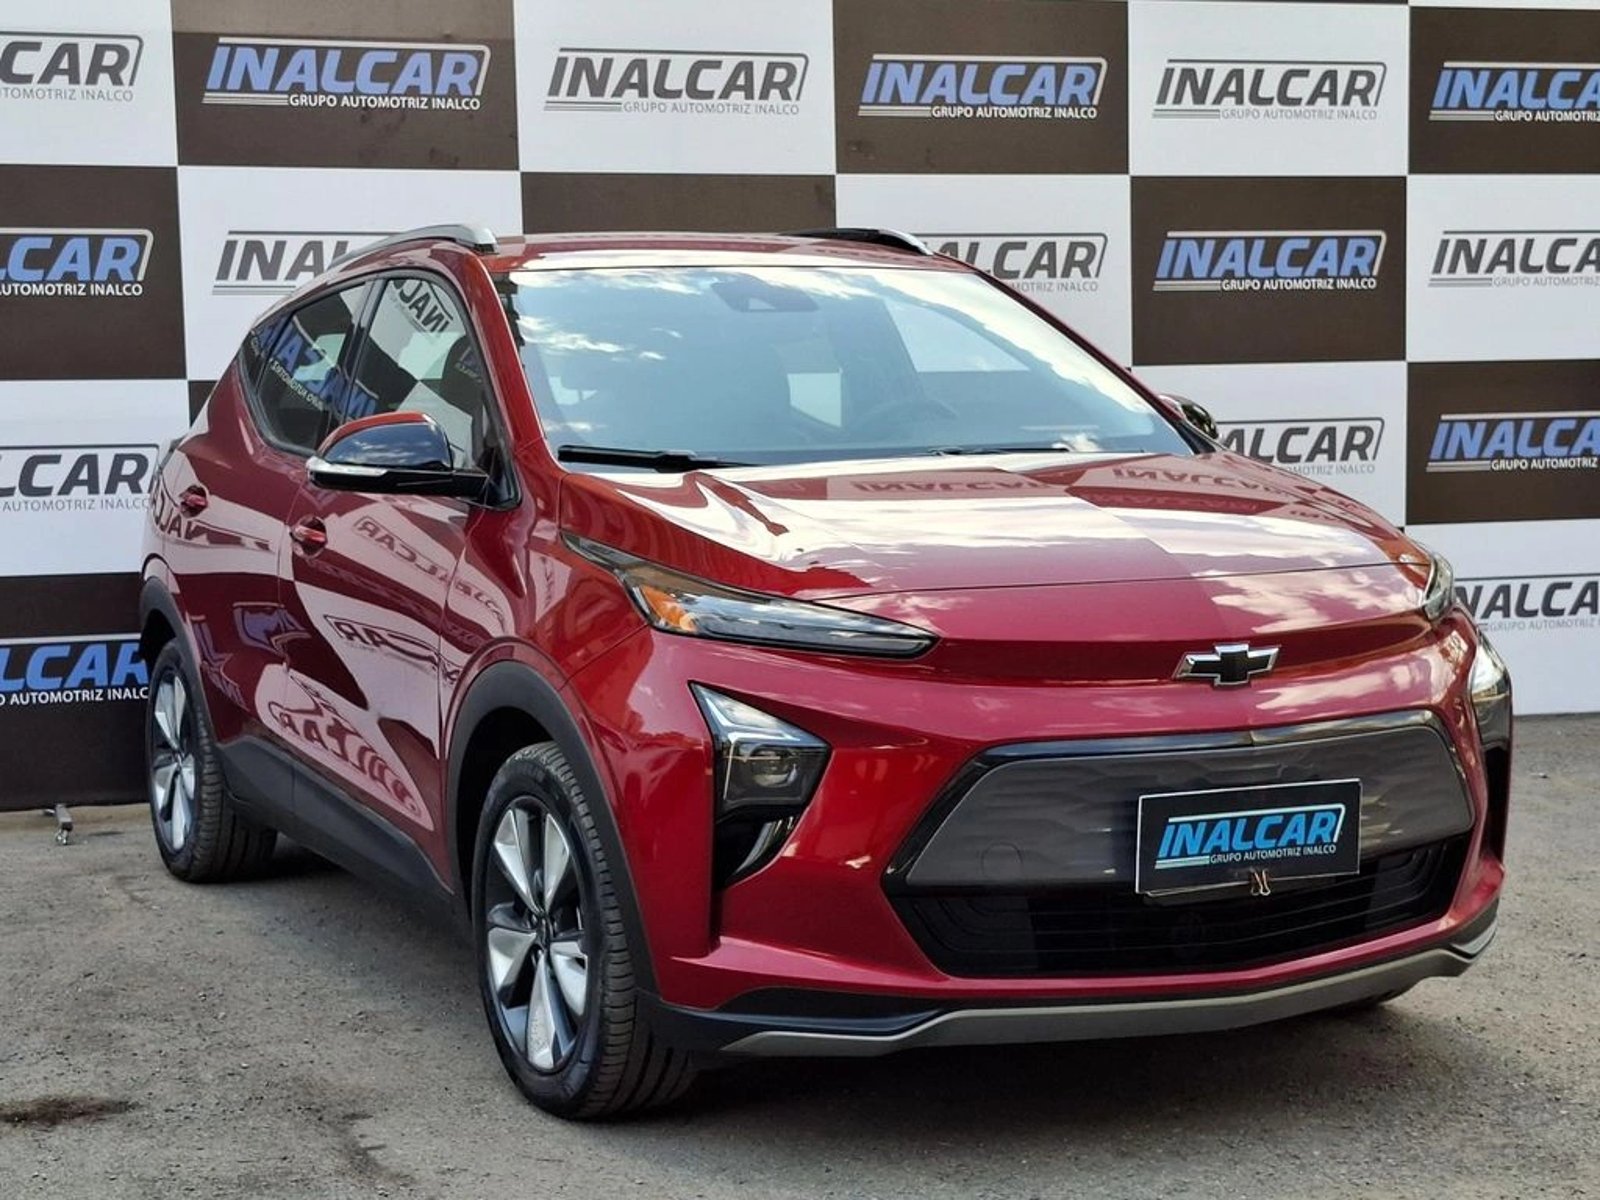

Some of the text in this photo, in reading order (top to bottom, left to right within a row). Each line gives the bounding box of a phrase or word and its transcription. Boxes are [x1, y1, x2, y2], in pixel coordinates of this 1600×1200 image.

[0, 41, 130, 86] CAR
[206, 45, 481, 96] INALCAR
[547, 55, 797, 101] INALCAR
[861, 62, 1098, 106] INALCAR
[1156, 68, 1377, 107] INALCAR
[81, 90, 134, 102] INALCO
[289, 94, 481, 111] GRUPO AUTOMOTRIZ INALCO
[623, 102, 799, 116] GRUPO AUTOMOTRIZ INALCO
[931, 105, 1098, 119] GRUPO AUTOMOTRIZ INALCO
[1221, 109, 1377, 121] GRUPO AUTOMOTRIZ INALCO
[1494, 111, 1532, 122] GRUPO
[1155, 238, 1378, 279] INALCAR
[1056, 281, 1098, 293] INALCO
[1222, 277, 1377, 290] GRUPO AUTOMOTRIZ INALCO
[1493, 276, 1530, 288] GRUPO
[90, 283, 143, 296] INALCO
[1335, 463, 1375, 475] INALCO
[1492, 459, 1528, 471] GRUPO
[1531, 457, 1598, 470] AUTOMOTRIZ
[3, 499, 96, 513] AUTOMOTRIZ
[1529, 617, 1595, 631] AUTOMOTRIZ
[10, 688, 104, 706] AUTOMOTRIZ
[1158, 811, 1338, 858] INALCAR
[1210, 843, 1336, 864] GRUPO AUTOMOTRIZ INALCO
